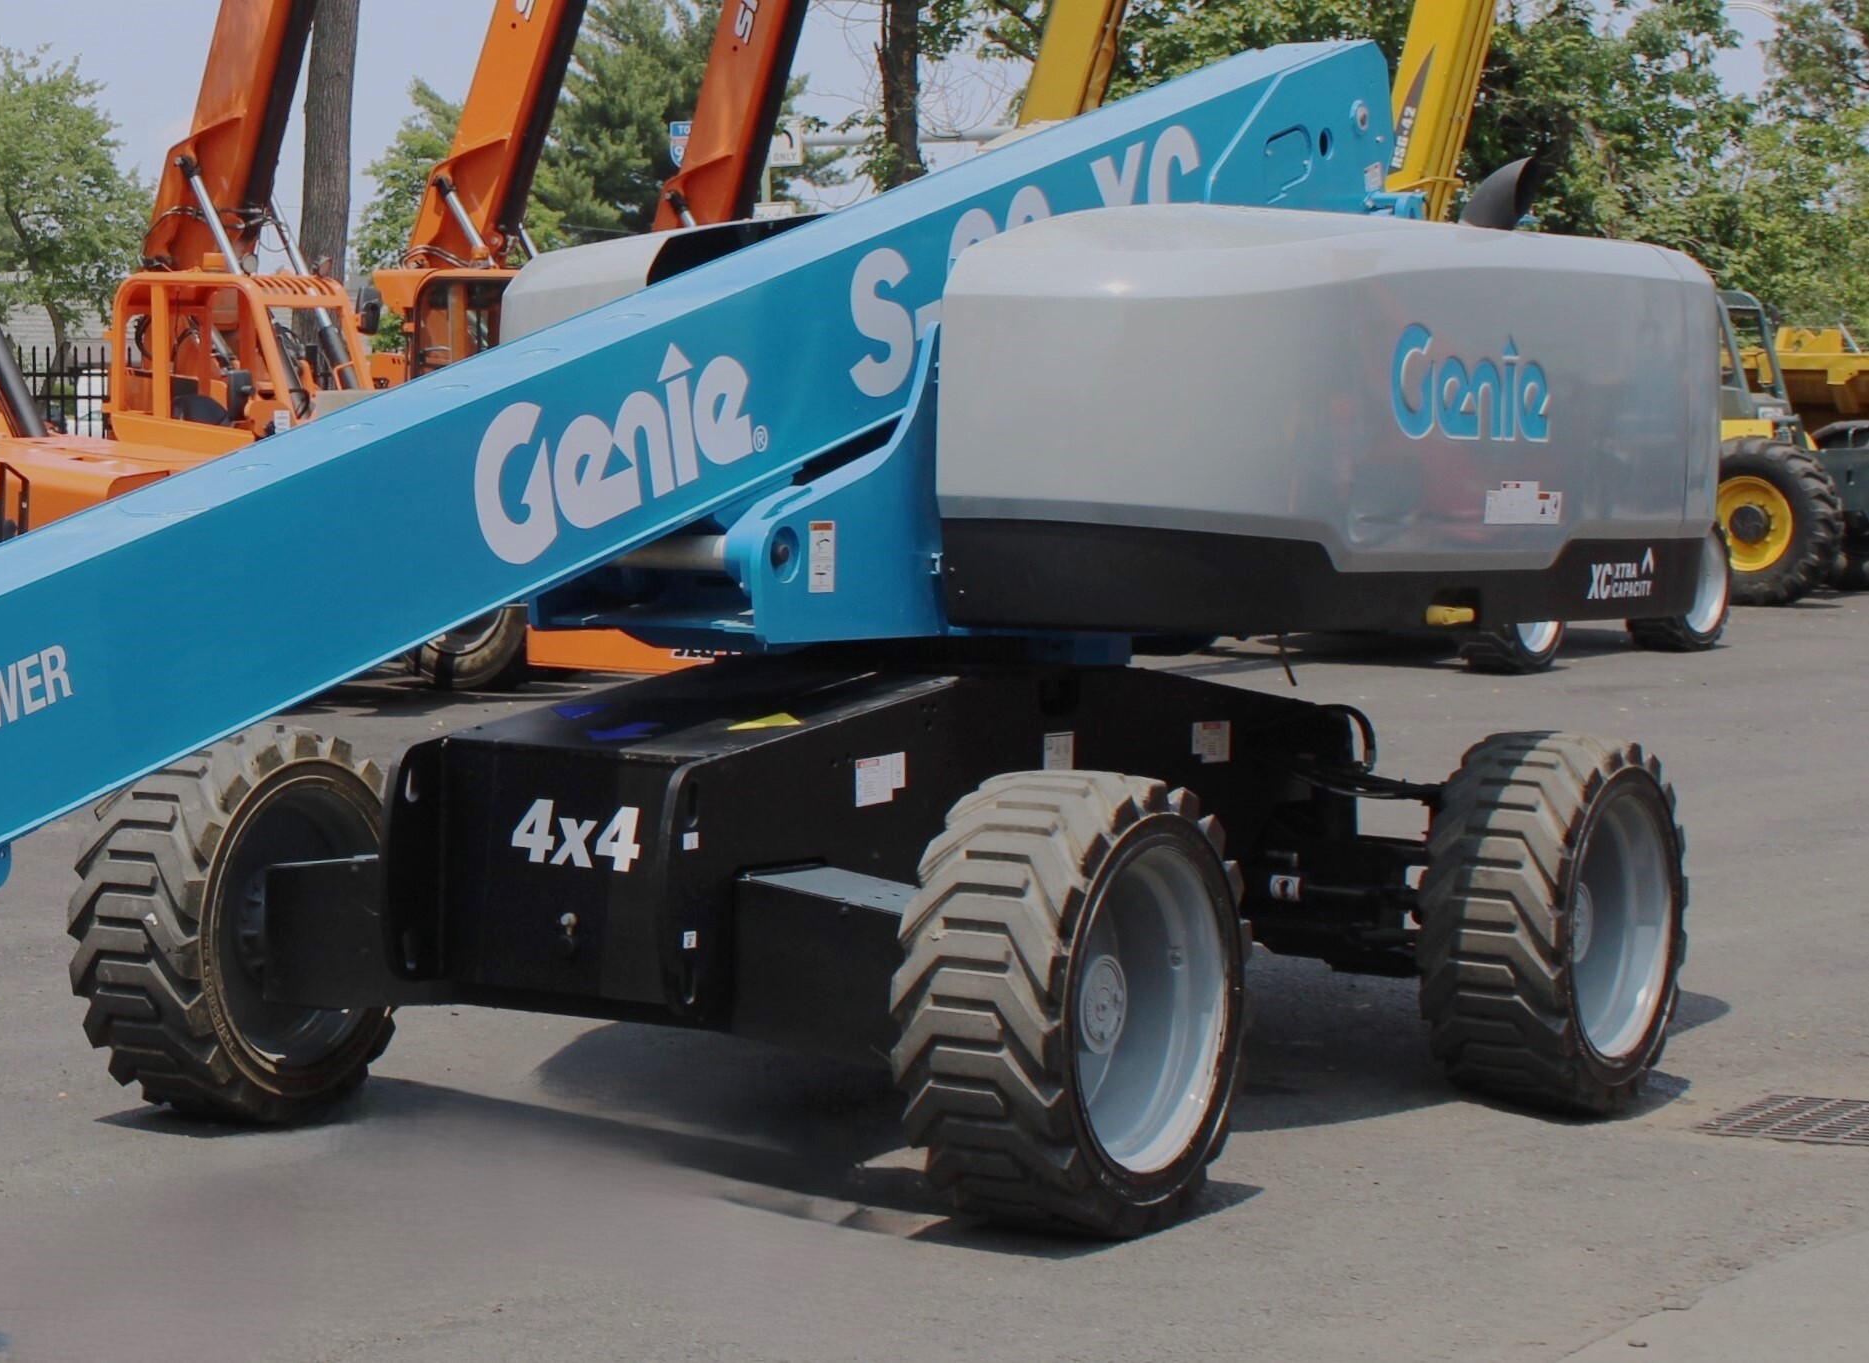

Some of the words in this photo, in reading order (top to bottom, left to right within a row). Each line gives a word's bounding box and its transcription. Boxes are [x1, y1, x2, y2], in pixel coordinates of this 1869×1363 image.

[1390, 323, 1550, 443] Genie
[474, 342, 754, 565] Genie
[1587, 563, 1613, 599] XC
[1612, 580, 1652, 598] CAPACITY
[1613, 562, 1637, 579] XTRA
[511, 798, 641, 873] 4x4
